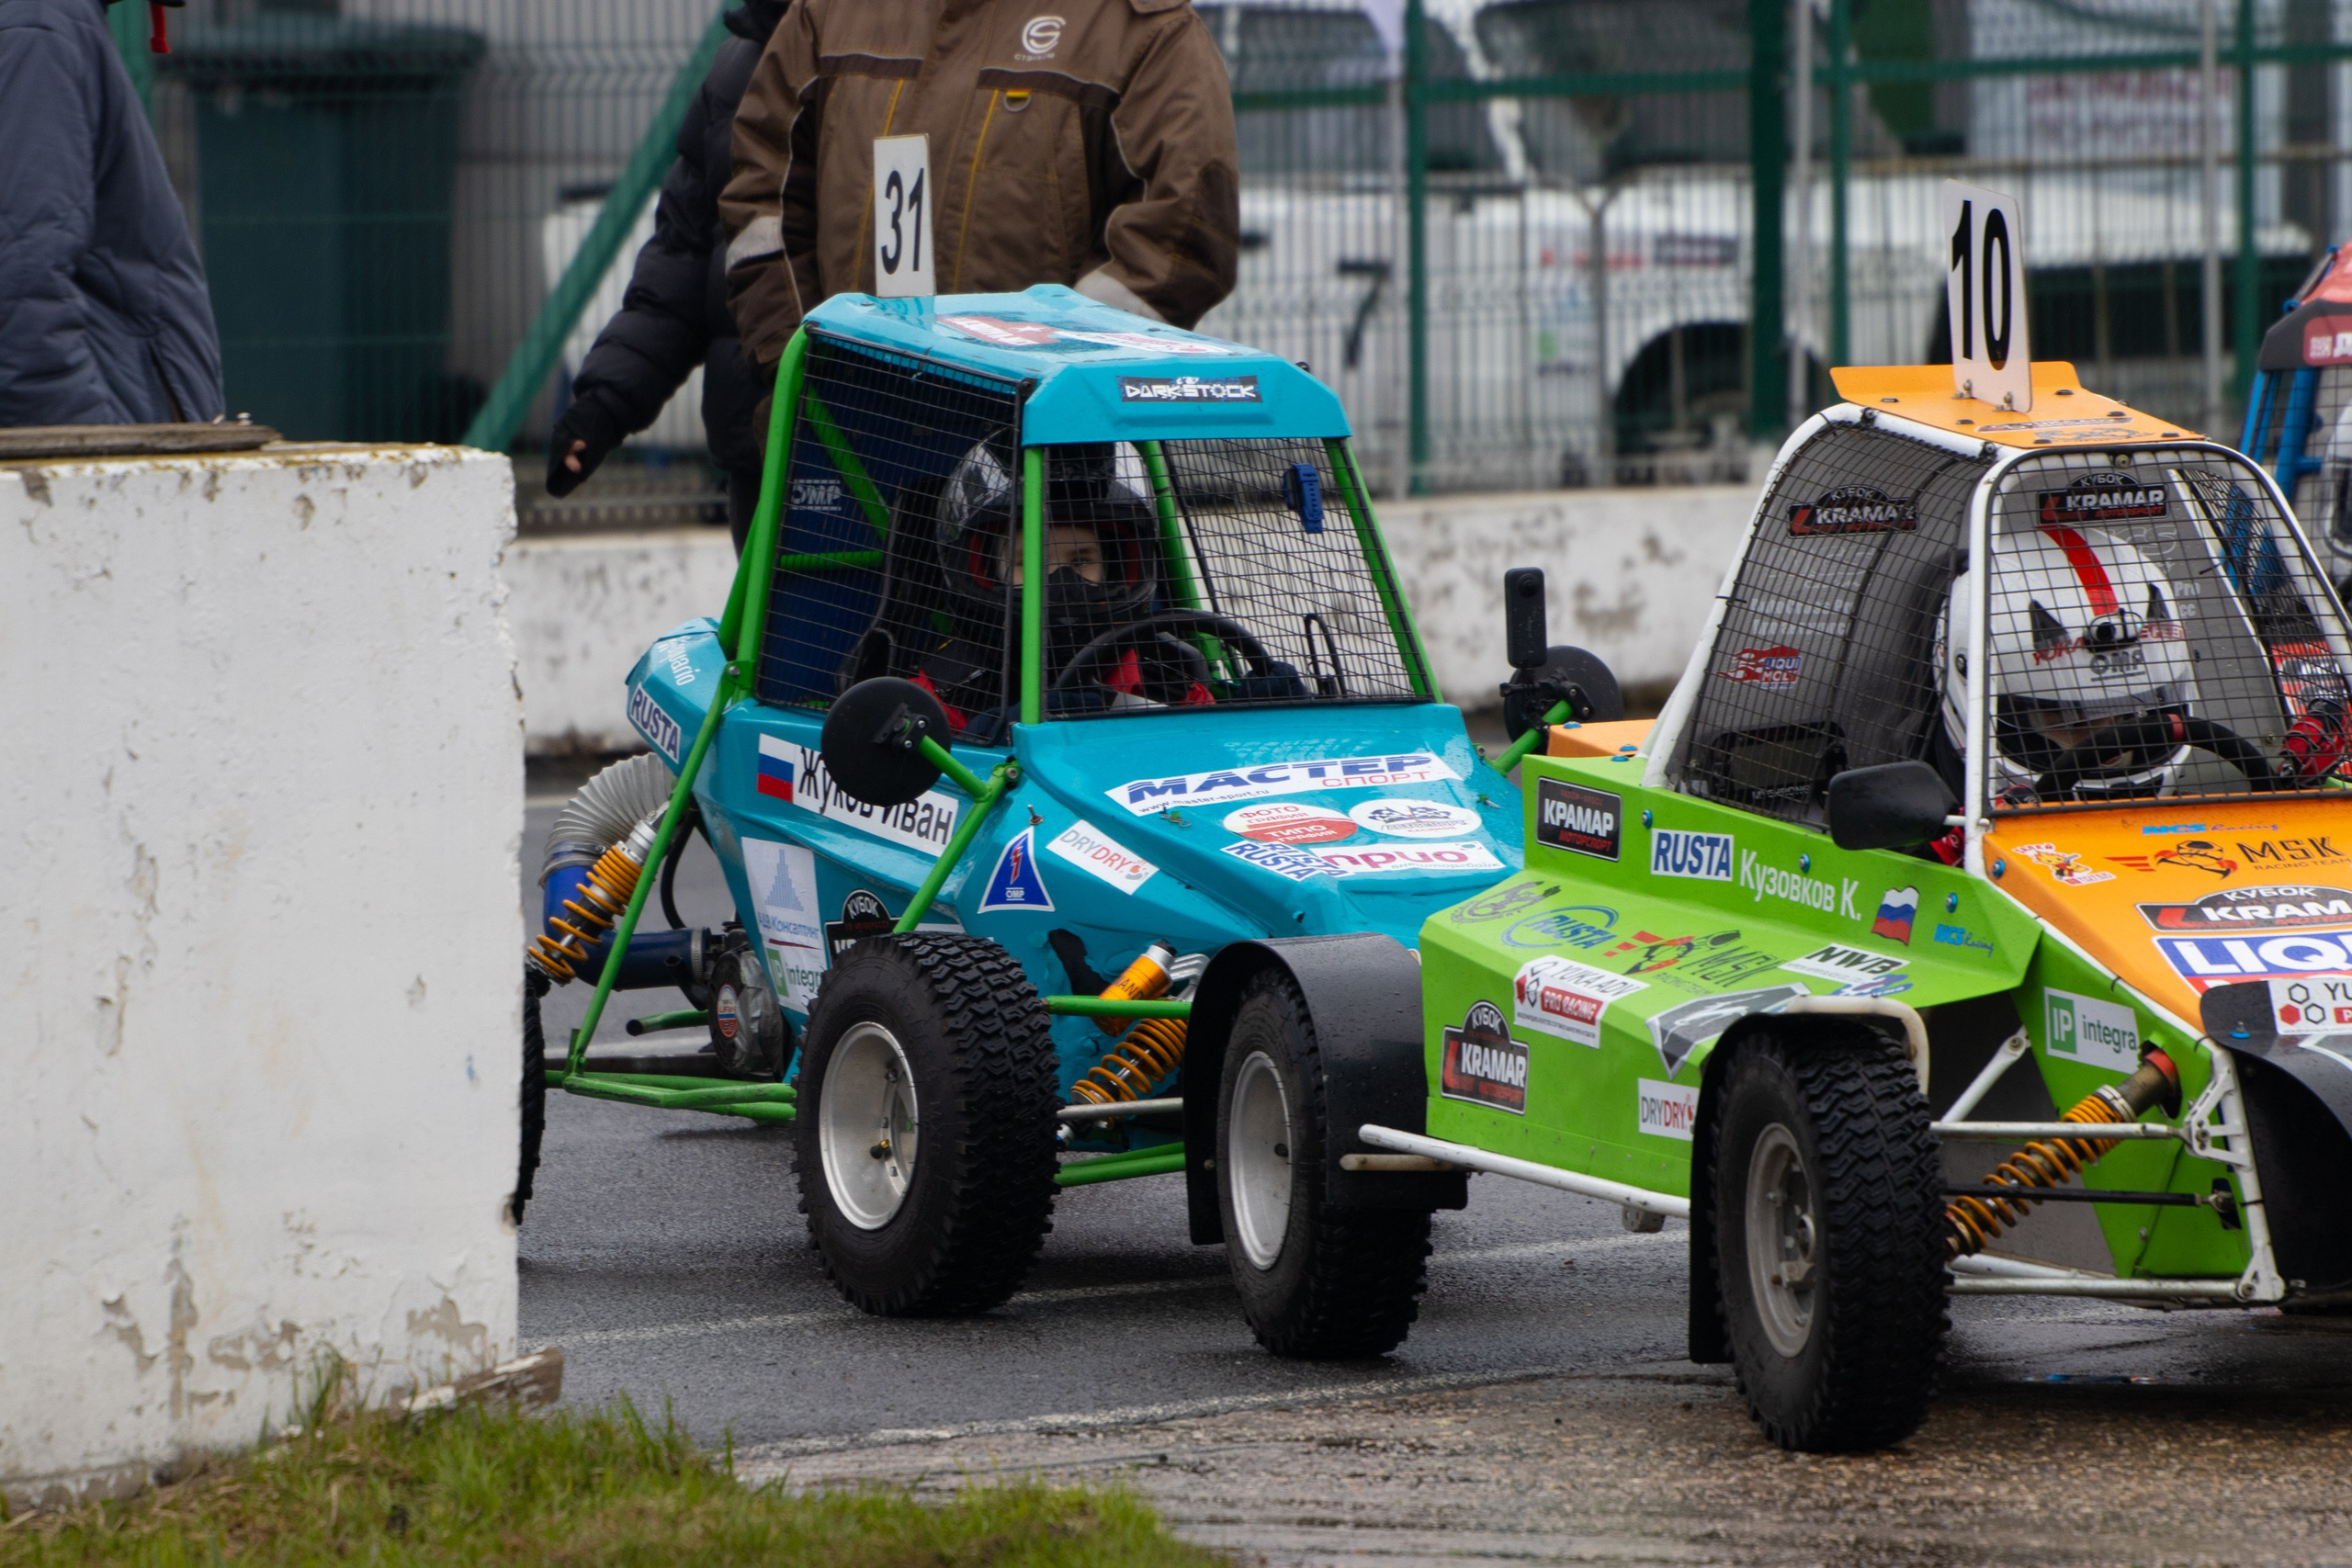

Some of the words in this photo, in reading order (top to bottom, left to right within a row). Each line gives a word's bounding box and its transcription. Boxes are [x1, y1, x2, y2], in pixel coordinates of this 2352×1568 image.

[880, 167, 925, 276] 31
[1951, 198, 2012, 371] 10
[1125, 383, 1257, 399] DARKSTOCK
[2079, 473, 2125, 487] КУБОК
[2066, 489, 2165, 512] KRAMAR
[630, 687, 679, 761] RUSTA
[1127, 753, 1433, 805] МАСТЕР
[1321, 770, 1431, 788] СПОРТ
[1138, 788, 1271, 814] www.master-sport.ru
[1238, 805, 1300, 818] ФОТО
[881, 798, 953, 845] Иван
[1247, 812, 1309, 824] ГРАФИЯ
[1263, 824, 1329, 838] ТИПО
[1544, 798, 1615, 838] КРАМАР
[2142, 823, 2208, 835] NCS
[1278, 829, 1338, 842] ГРАФИЯ
[2235, 836, 2346, 864] MSK
[1059, 829, 1130, 874] DRYDRY
[1225, 842, 1317, 880] RUSTA
[1655, 832, 1731, 878] RUSTA
[2253, 861, 2309, 872] RACING
[2312, 858, 2352, 867] TEAM
[1005, 889, 1025, 899] OMP
[1740, 849, 1836, 913] Кузовков
[1839, 877, 1862, 921] К.
[2222, 886, 2317, 902] КУБОК
[846, 895, 881, 919] КУБОК
[1525, 915, 1618, 950] RUSTA
[1933, 923, 1966, 947] NCS
[1804, 945, 1903, 975] NWB
[785, 963, 823, 993] integr
[1544, 990, 1562, 1011] PRO
[1564, 995, 1598, 1021] RACING
[1471, 1007, 1502, 1035] КУБОК
[2052, 1006, 2074, 1043] IP
[2081, 1014, 2138, 1055] integra
[1460, 1042, 1526, 1089] KRAMAR
[1640, 1096, 1687, 1131] DRYDRY
